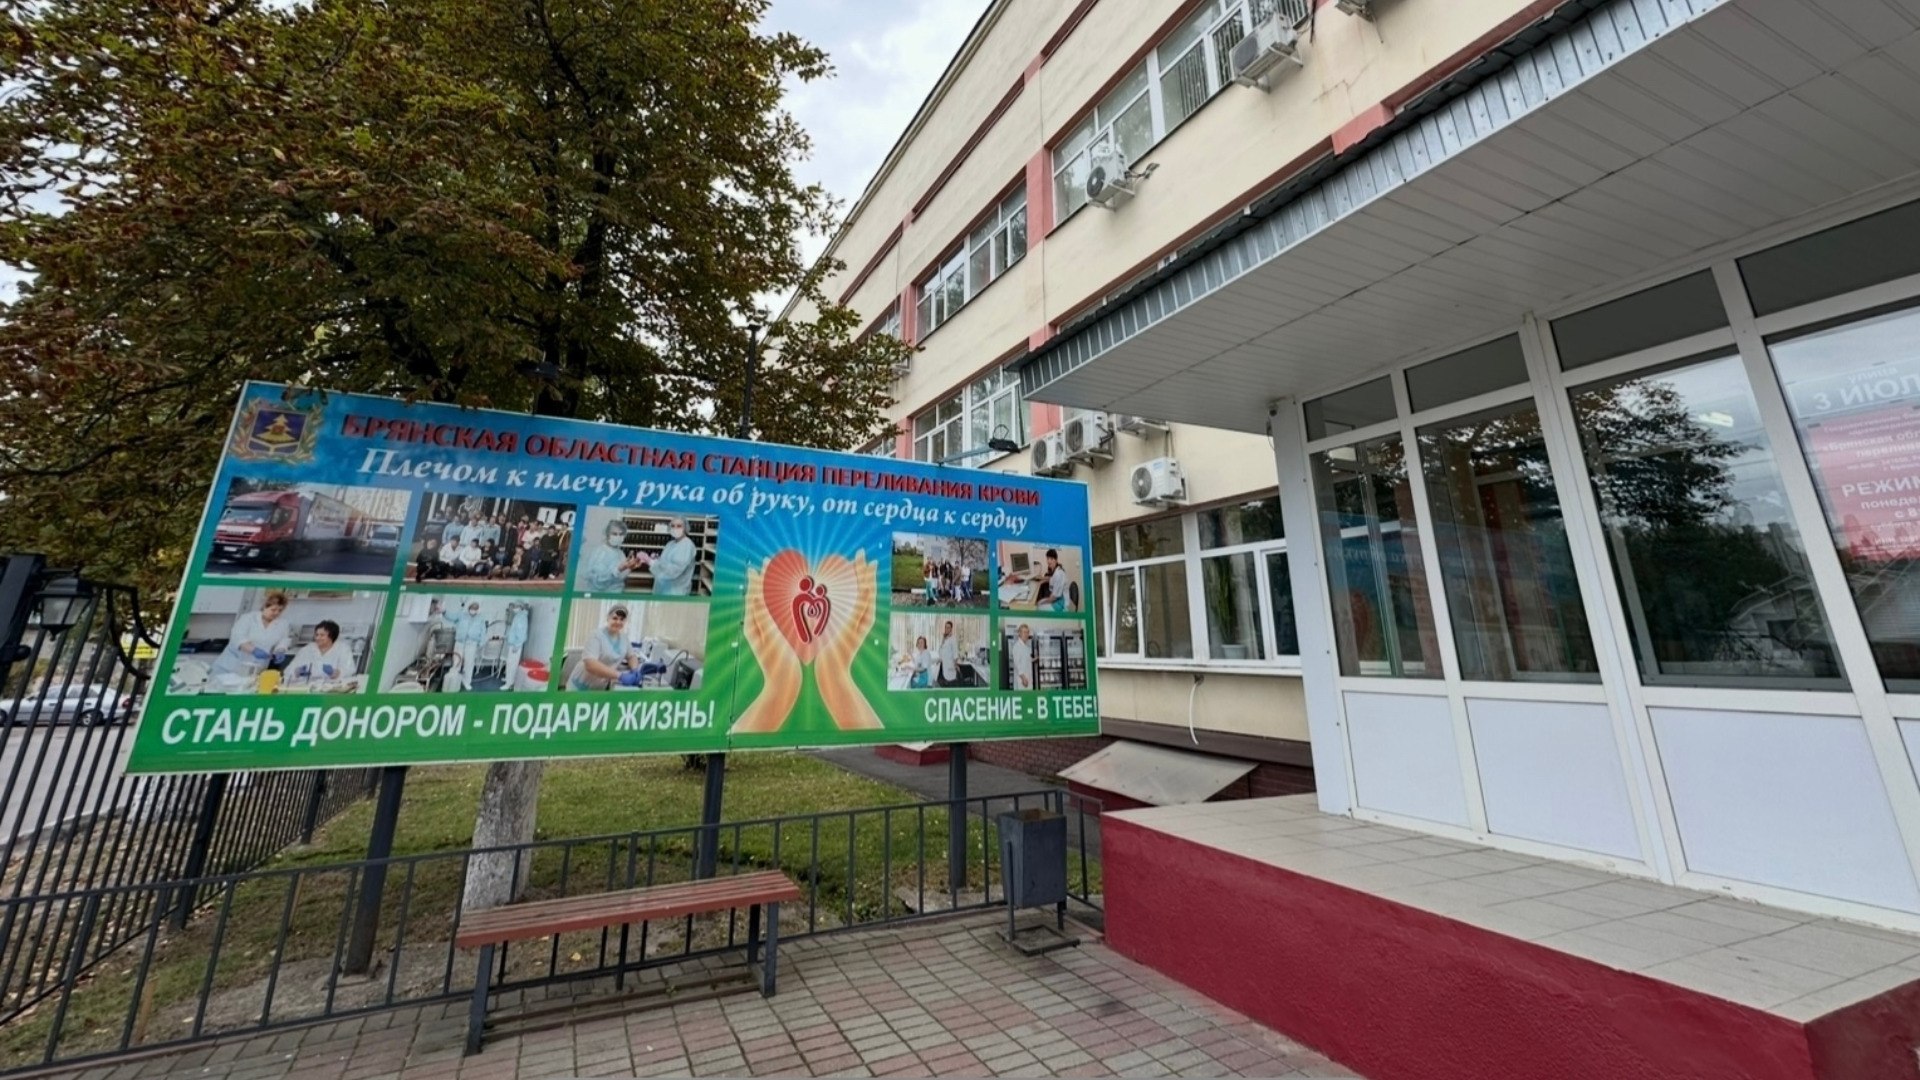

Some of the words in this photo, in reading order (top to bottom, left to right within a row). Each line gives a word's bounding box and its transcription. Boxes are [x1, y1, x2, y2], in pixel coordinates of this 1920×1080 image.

[1814, 392, 1832, 411] 3
[341, 413, 517, 454] БРЯНСКАЯ
[525, 433, 696, 471] ОБЛАСТНАЯ
[702, 453, 816, 484] СТАНЦИЯ
[822, 467, 974, 500] ПЕРЕЛИВАНИЯ
[978, 485, 1041, 506] КРОВИ
[356, 447, 498, 484] Плечом
[506, 467, 528, 487] к
[533, 472, 628, 506] плечу,
[635, 482, 705, 506] рука
[712, 482, 744, 505] об
[746, 489, 816, 520] руку,
[822, 496, 858, 515] от
[863, 497, 940, 530] сердца
[943, 511, 957, 525] к
[961, 506, 1028, 535] сердцу
[161, 705, 286, 745] СТАНЬ
[291, 702, 465, 748] ДОНОРОМ
[472, 720, 483, 728] -
[490, 701, 610, 740] ПОДАРИ
[615, 699, 715, 732] ЖИЗНЬ!
[924, 697, 1023, 724] СПАСЕНИЕ
[1037, 697, 1049, 720] В
[1052, 695, 1098, 719] ТЕБЕ!
